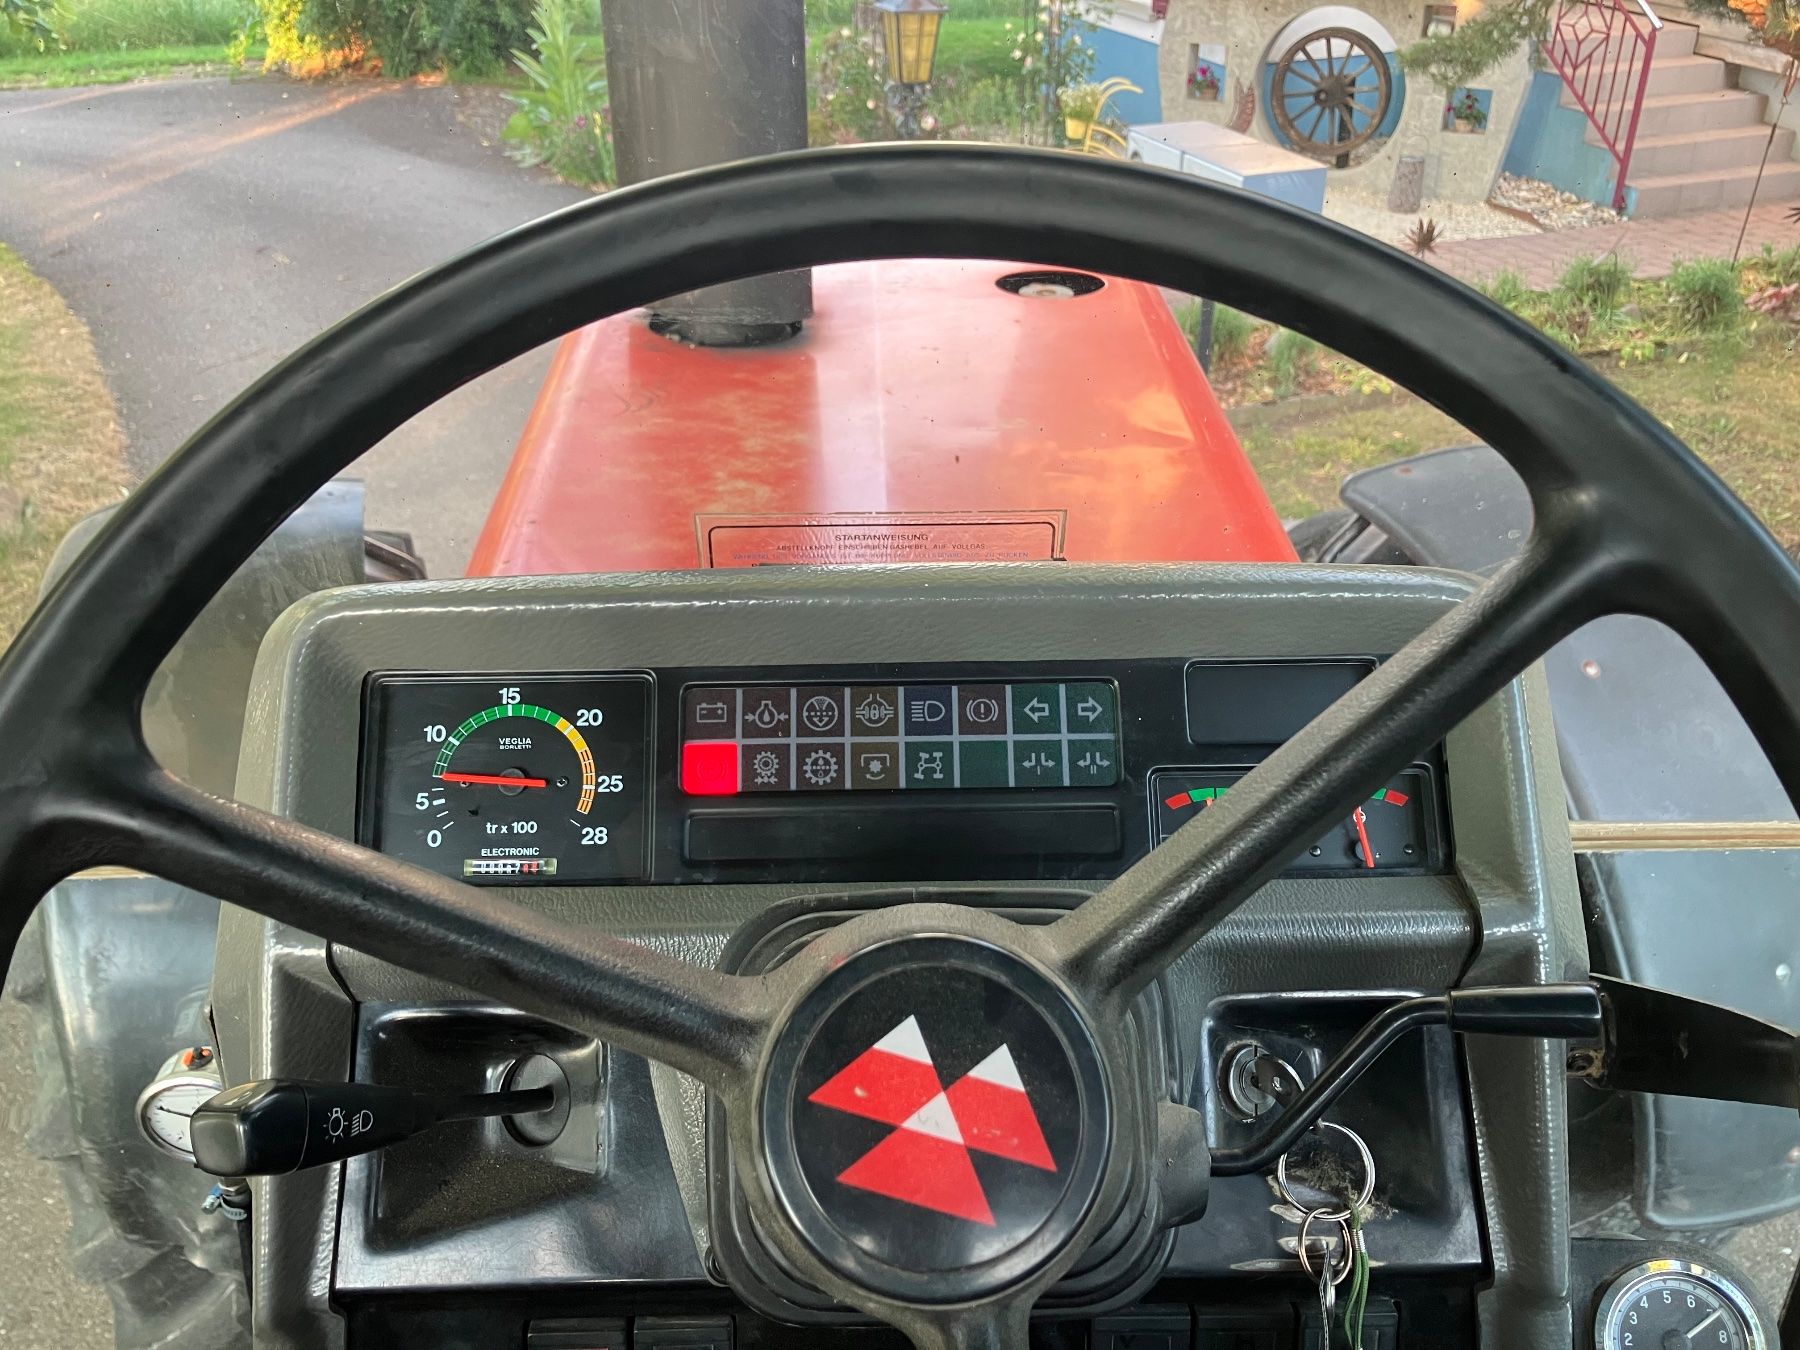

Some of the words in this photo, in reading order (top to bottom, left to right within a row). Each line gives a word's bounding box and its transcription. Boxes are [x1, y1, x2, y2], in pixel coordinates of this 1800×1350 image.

[499, 688, 521, 705] 15
[576, 709, 603, 727] 20
[423, 725, 447, 743] 10
[498, 737, 532, 745] VEGLIA
[597, 775, 624, 793] 25
[415, 792, 429, 810] 5
[486, 821, 498, 834] tr
[500, 825, 508, 834] x
[511, 821, 538, 834] 100
[427, 830, 442, 848] 0
[581, 827, 608, 845] 28
[481, 847, 540, 857] ELECTRONIC
[1640, 1296, 1649, 1309] 4
[1663, 1291, 1672, 1304] 5
[1686, 1295, 1696, 1308] 6
[1629, 1312, 1638, 1325] 3
[1624, 1333, 1633, 1346] 2
[1719, 1331, 1728, 1344] 8
